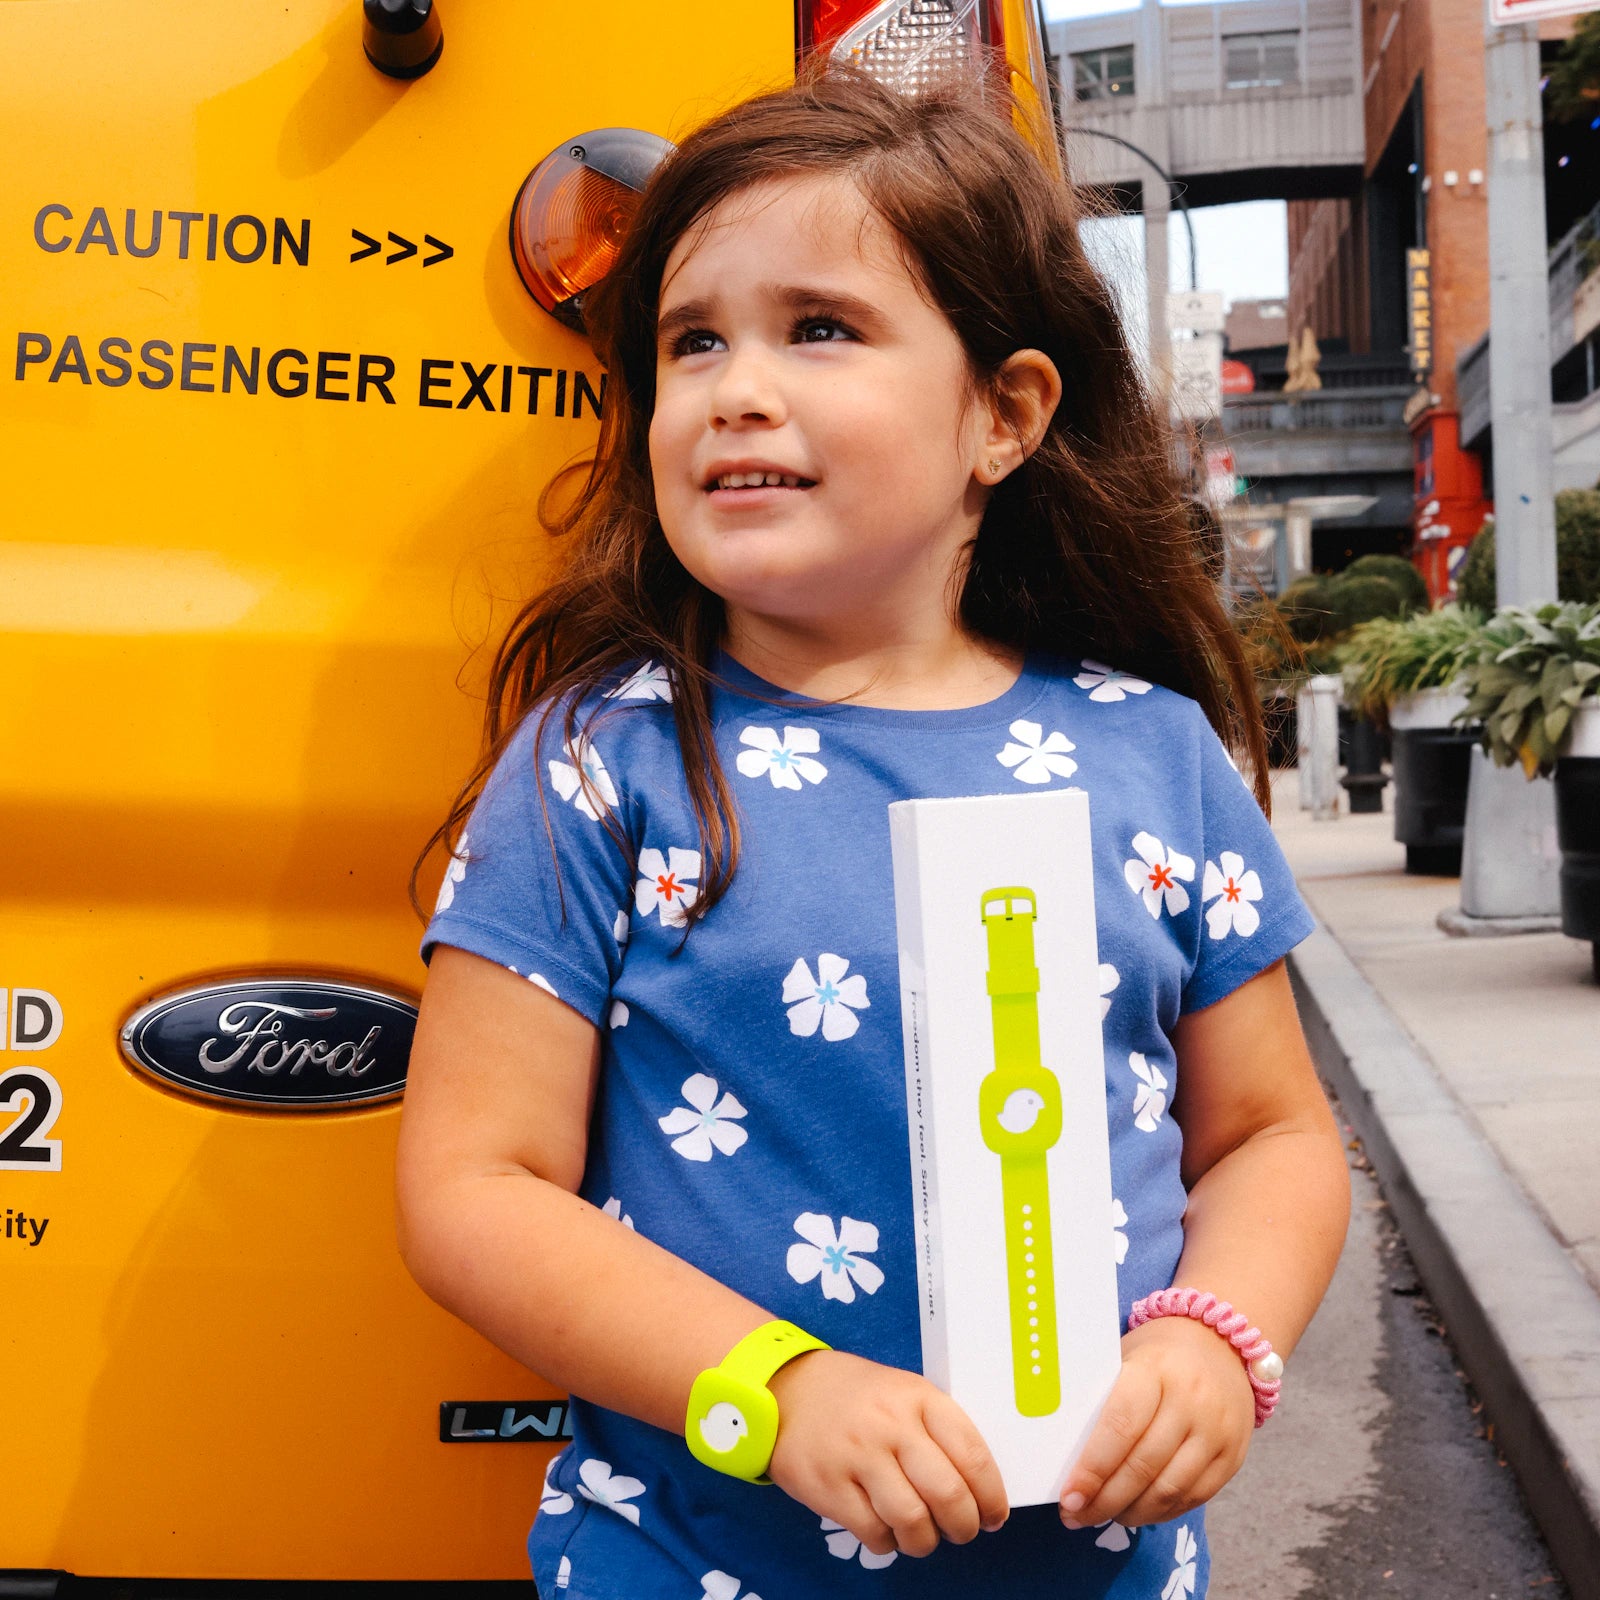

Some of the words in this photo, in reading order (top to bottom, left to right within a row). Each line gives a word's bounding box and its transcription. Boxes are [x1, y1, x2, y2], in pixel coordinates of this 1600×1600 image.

[33, 203, 311, 267] CAUTION
[1408, 249, 1431, 369] MARKET
[14, 331, 397, 405] PASSENGER
[198, 1001, 382, 1077] Ford
[911, 991, 920, 1072] Freedom
[920, 1169, 929, 1227] Safety
[0, 1208, 50, 1247] ity
